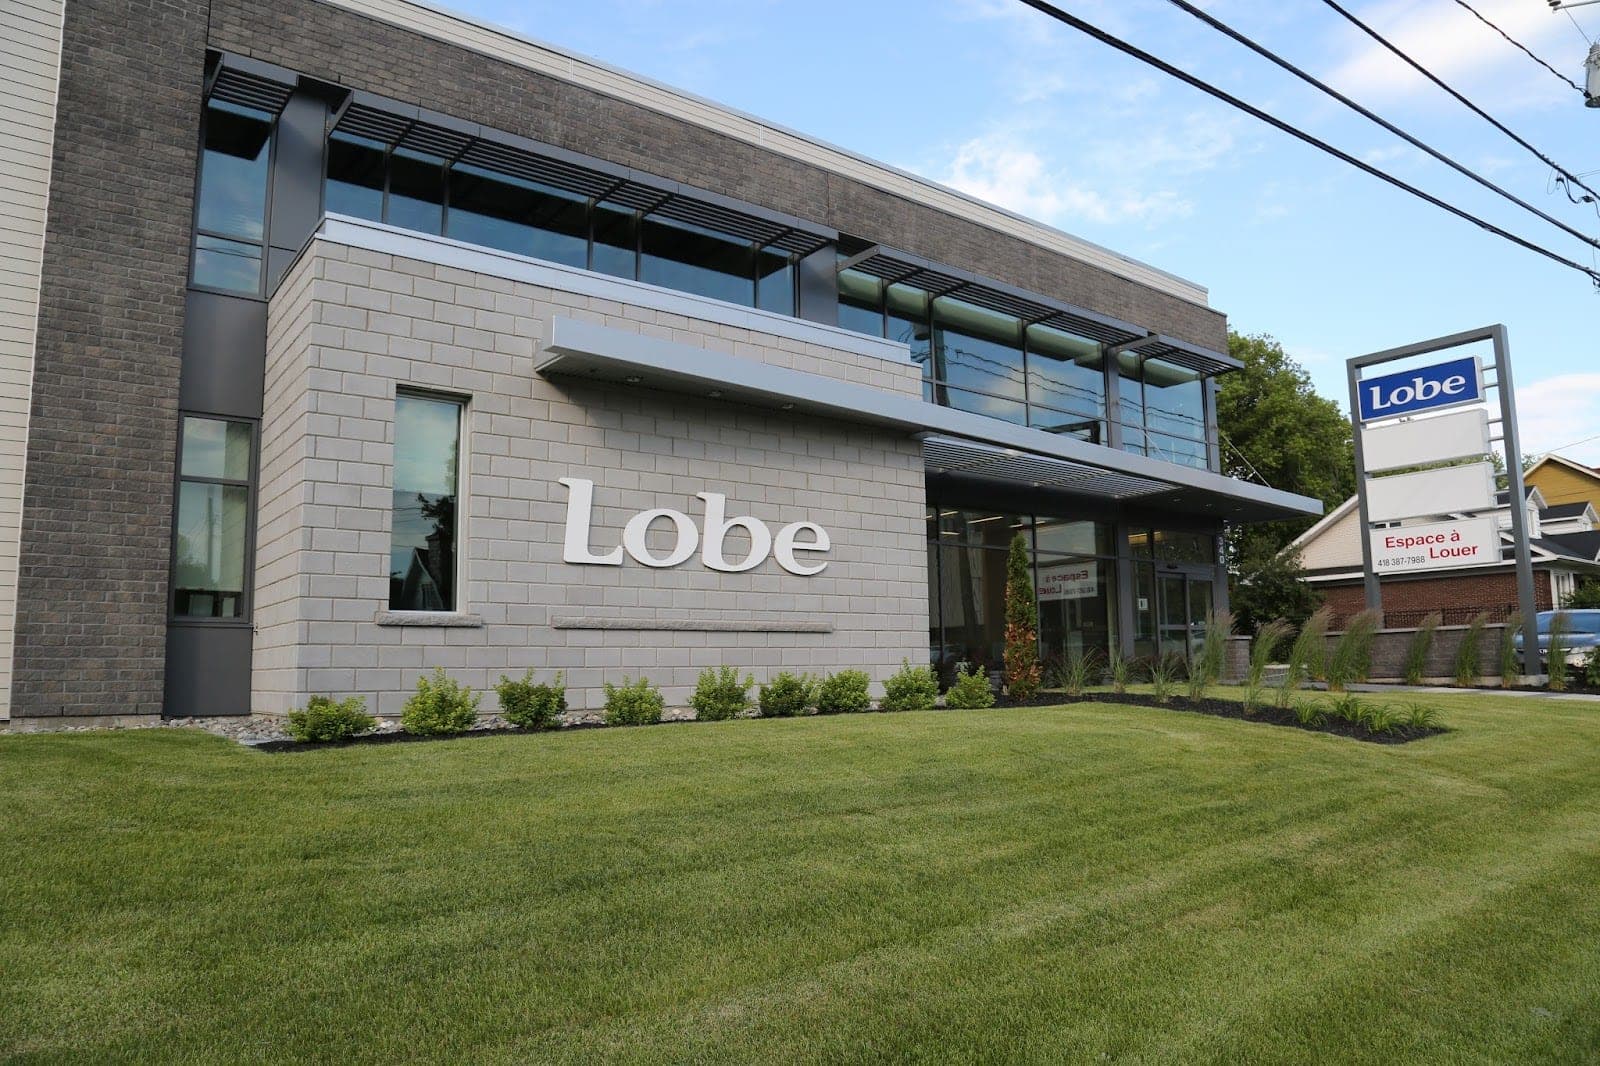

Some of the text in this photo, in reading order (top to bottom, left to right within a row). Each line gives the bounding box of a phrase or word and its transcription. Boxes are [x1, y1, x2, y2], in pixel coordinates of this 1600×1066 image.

[1369, 375, 1466, 410] Lobe
[558, 477, 831, 576] Lobe
[1385, 533, 1446, 549] Espace
[1429, 545, 1479, 559] Louer
[1377, 555, 1426, 567] 418 387-7988
